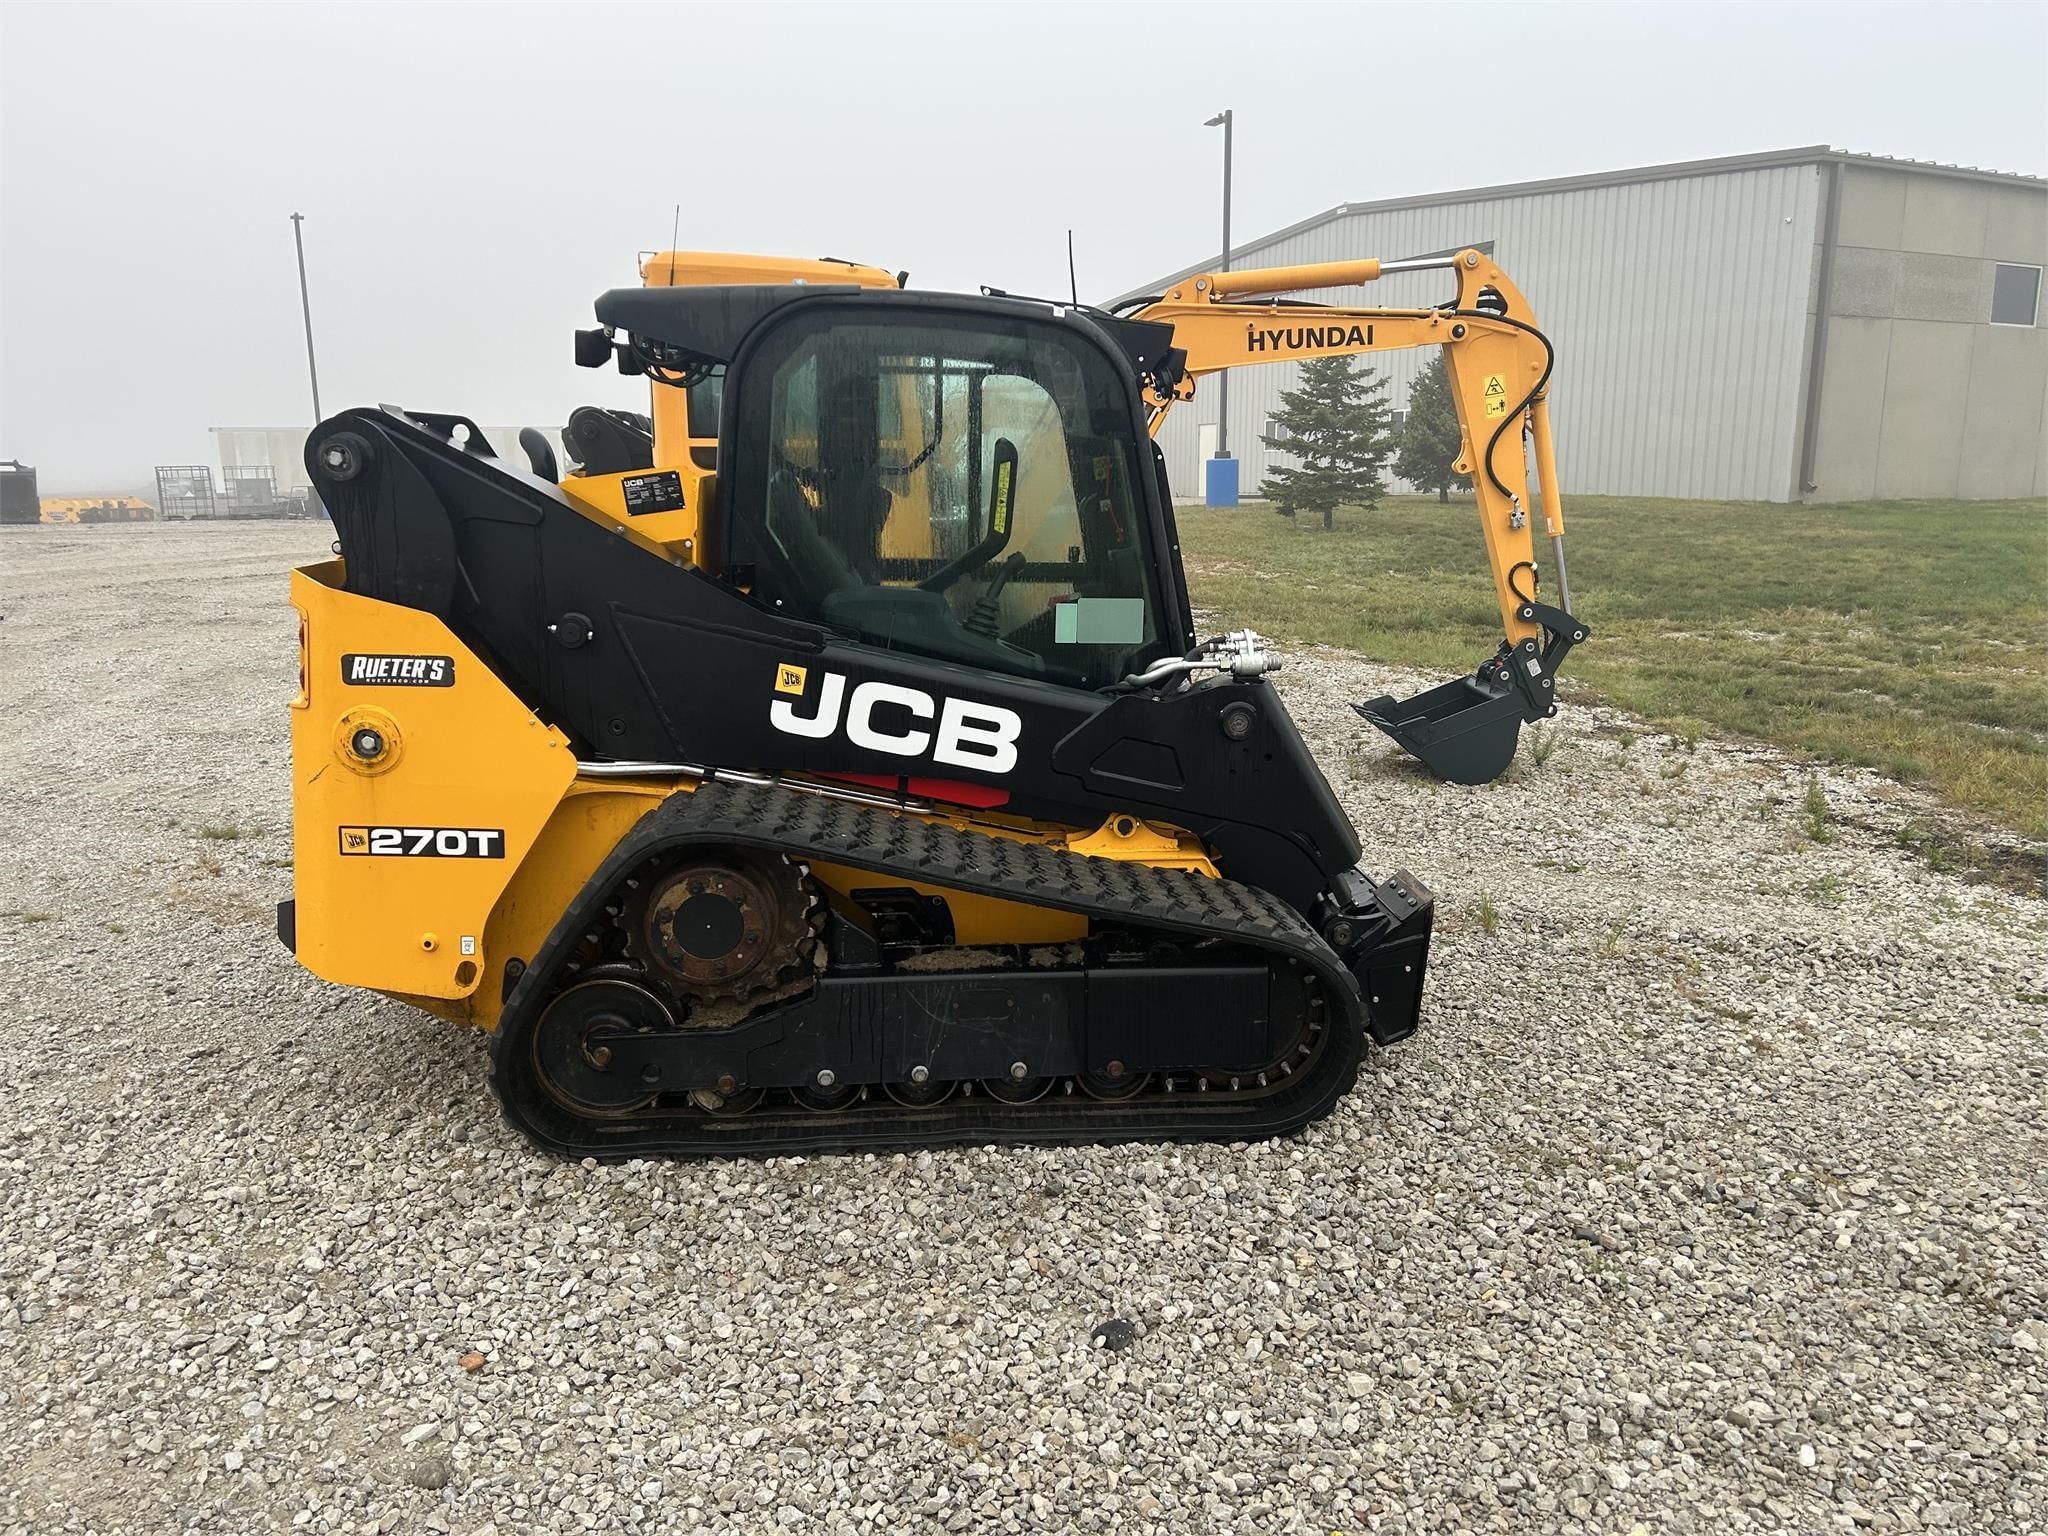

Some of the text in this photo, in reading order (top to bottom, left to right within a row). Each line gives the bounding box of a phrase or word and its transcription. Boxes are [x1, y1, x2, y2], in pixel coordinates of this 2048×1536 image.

[1248, 325, 1374, 351] HYUNDAI
[624, 479, 644, 487] JCB
[351, 656, 445, 680] RUETER'S
[783, 669, 801, 686] JCB
[770, 672, 1022, 774] JCB
[348, 828, 499, 857] JCB 270T
